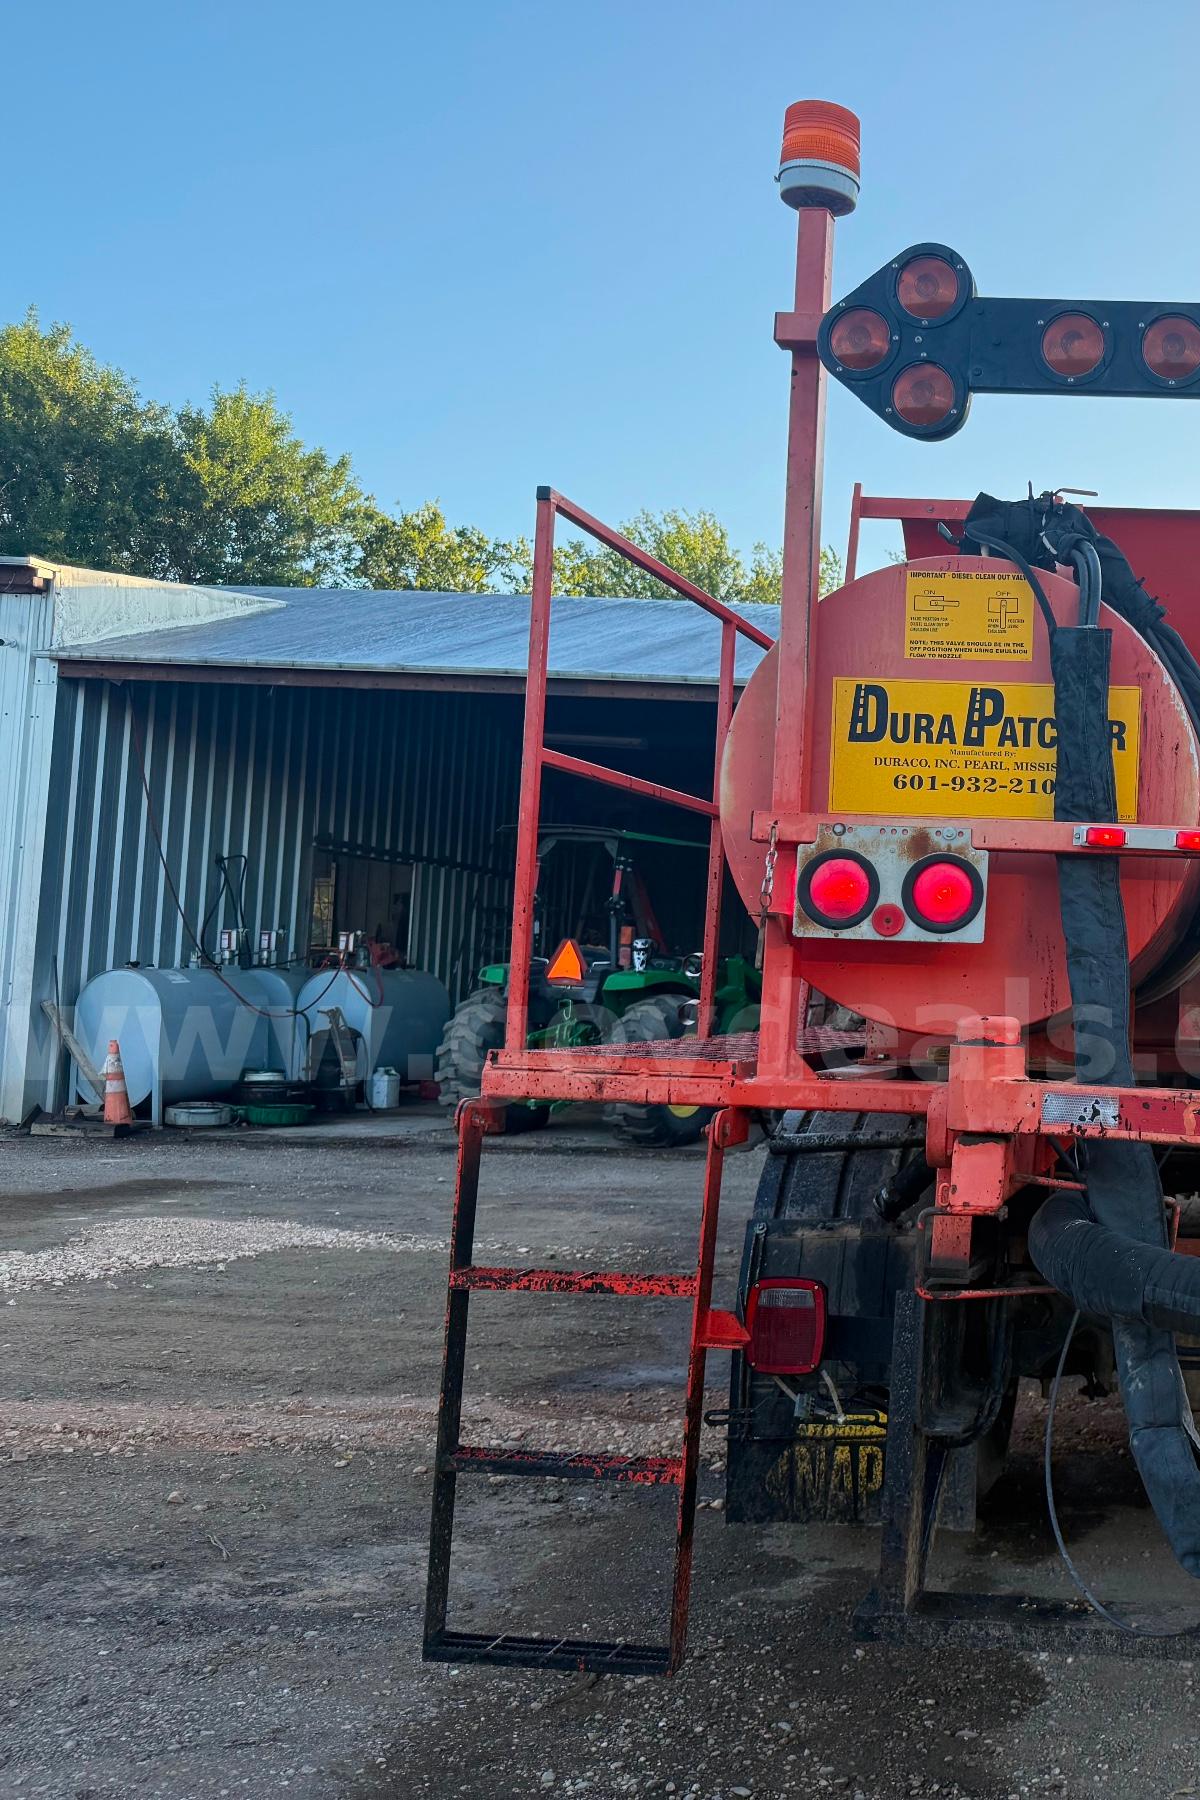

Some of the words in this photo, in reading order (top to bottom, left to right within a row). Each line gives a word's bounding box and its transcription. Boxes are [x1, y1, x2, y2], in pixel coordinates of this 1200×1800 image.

[910, 571, 946, 579] IMPORTANT
[848, 684, 957, 744] DURA
[963, 688, 1127, 752] PATCR
[949, 749, 1002, 758] Manufactured
[873, 757, 931, 769] DURACO,
[935, 759, 960, 769] INC.
[964, 760, 1010, 771] PEARL,
[1013, 761, 1058, 772] MISSIS
[893, 774, 1056, 795] 601-932-210
